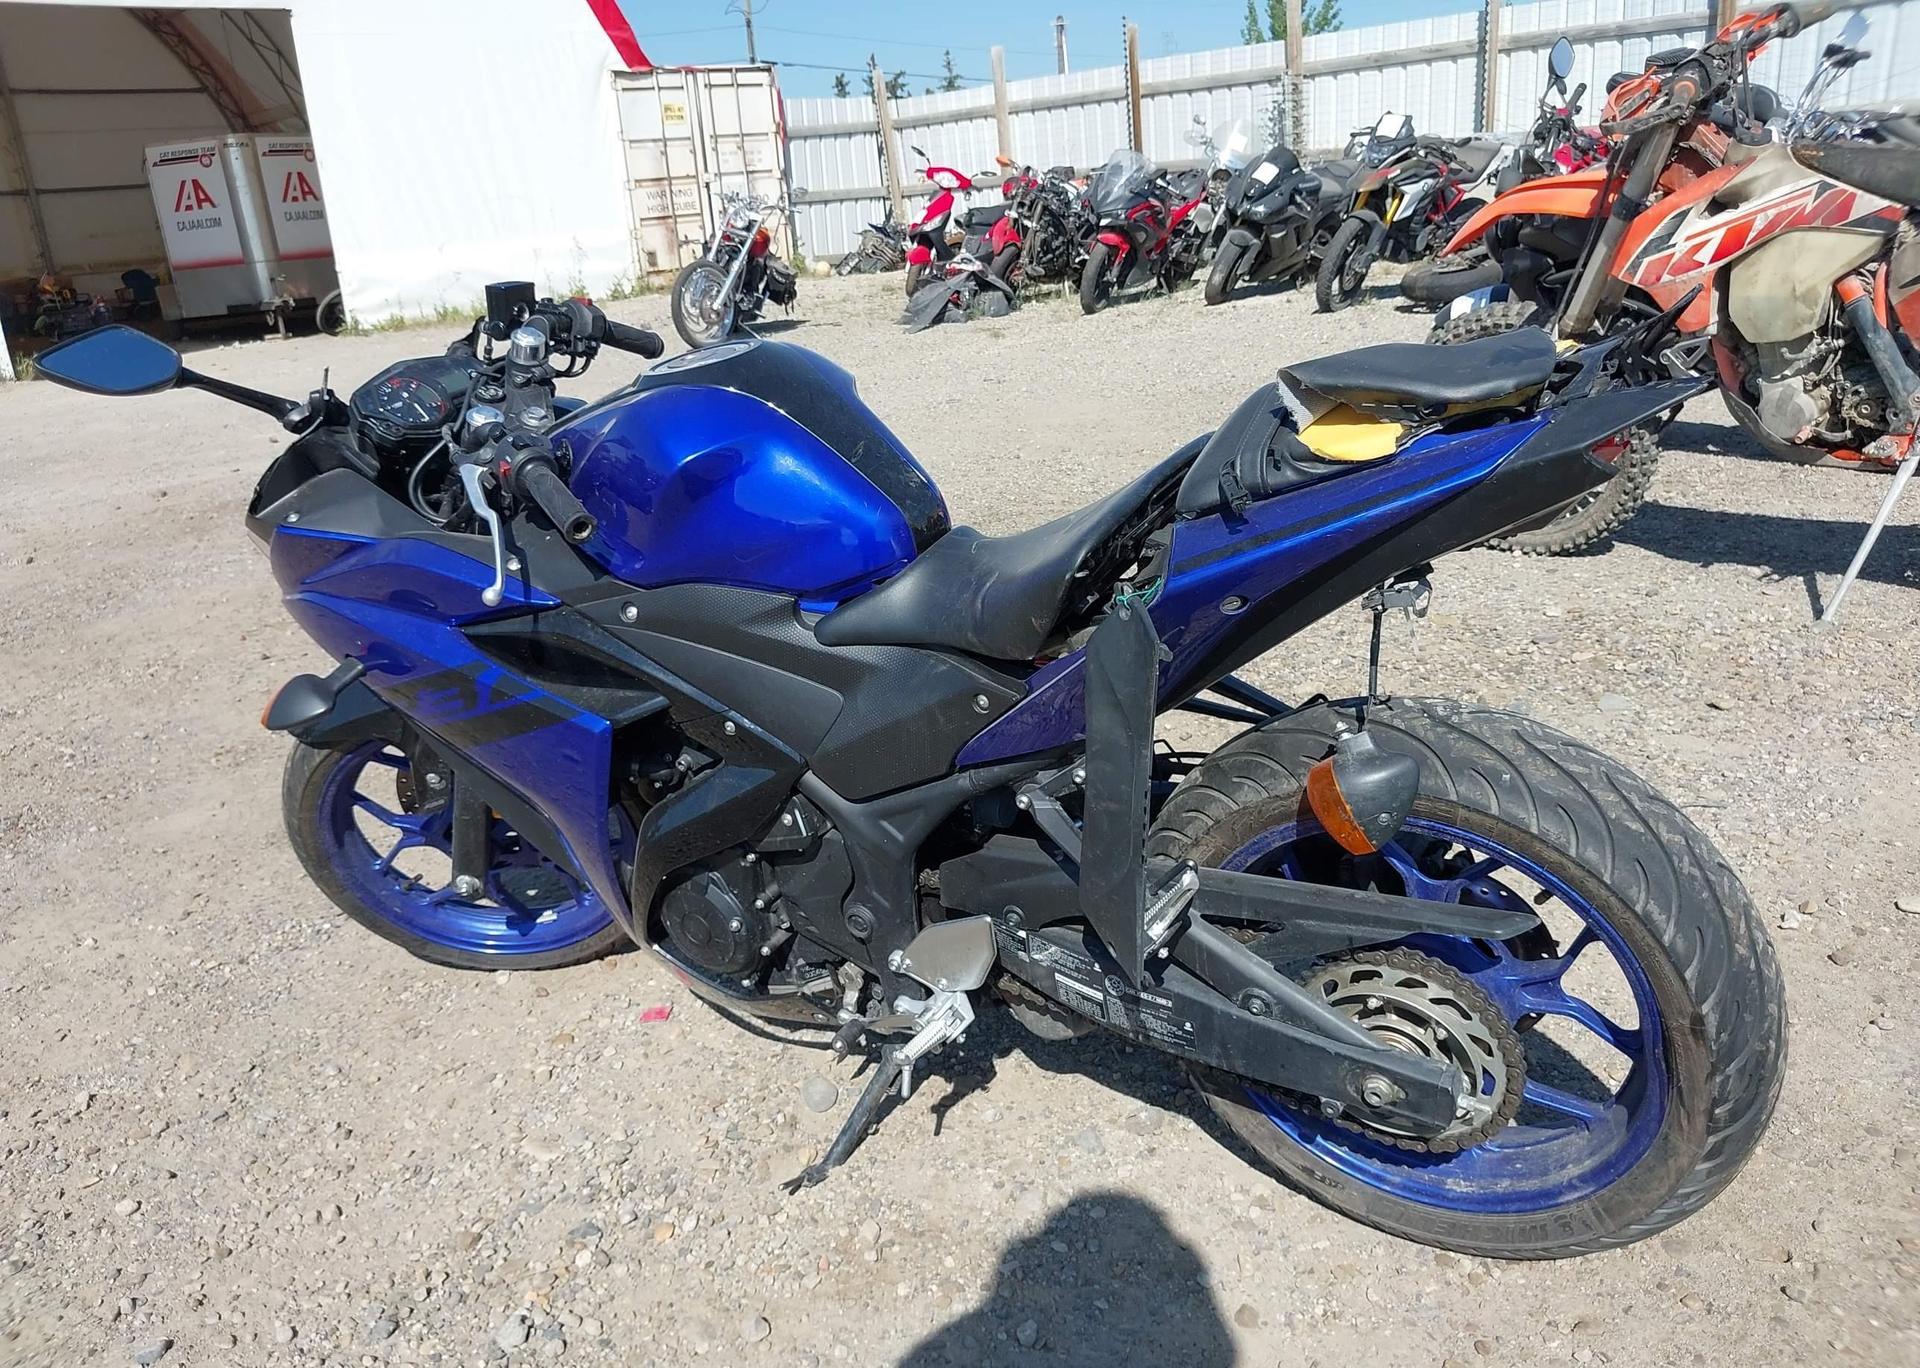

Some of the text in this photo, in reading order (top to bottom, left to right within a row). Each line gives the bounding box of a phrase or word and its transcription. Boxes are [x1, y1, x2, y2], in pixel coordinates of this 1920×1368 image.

[171, 148, 199, 157] RESPONSE
[200, 146, 216, 154] TEAM
[1636, 187, 1858, 287] KTM
